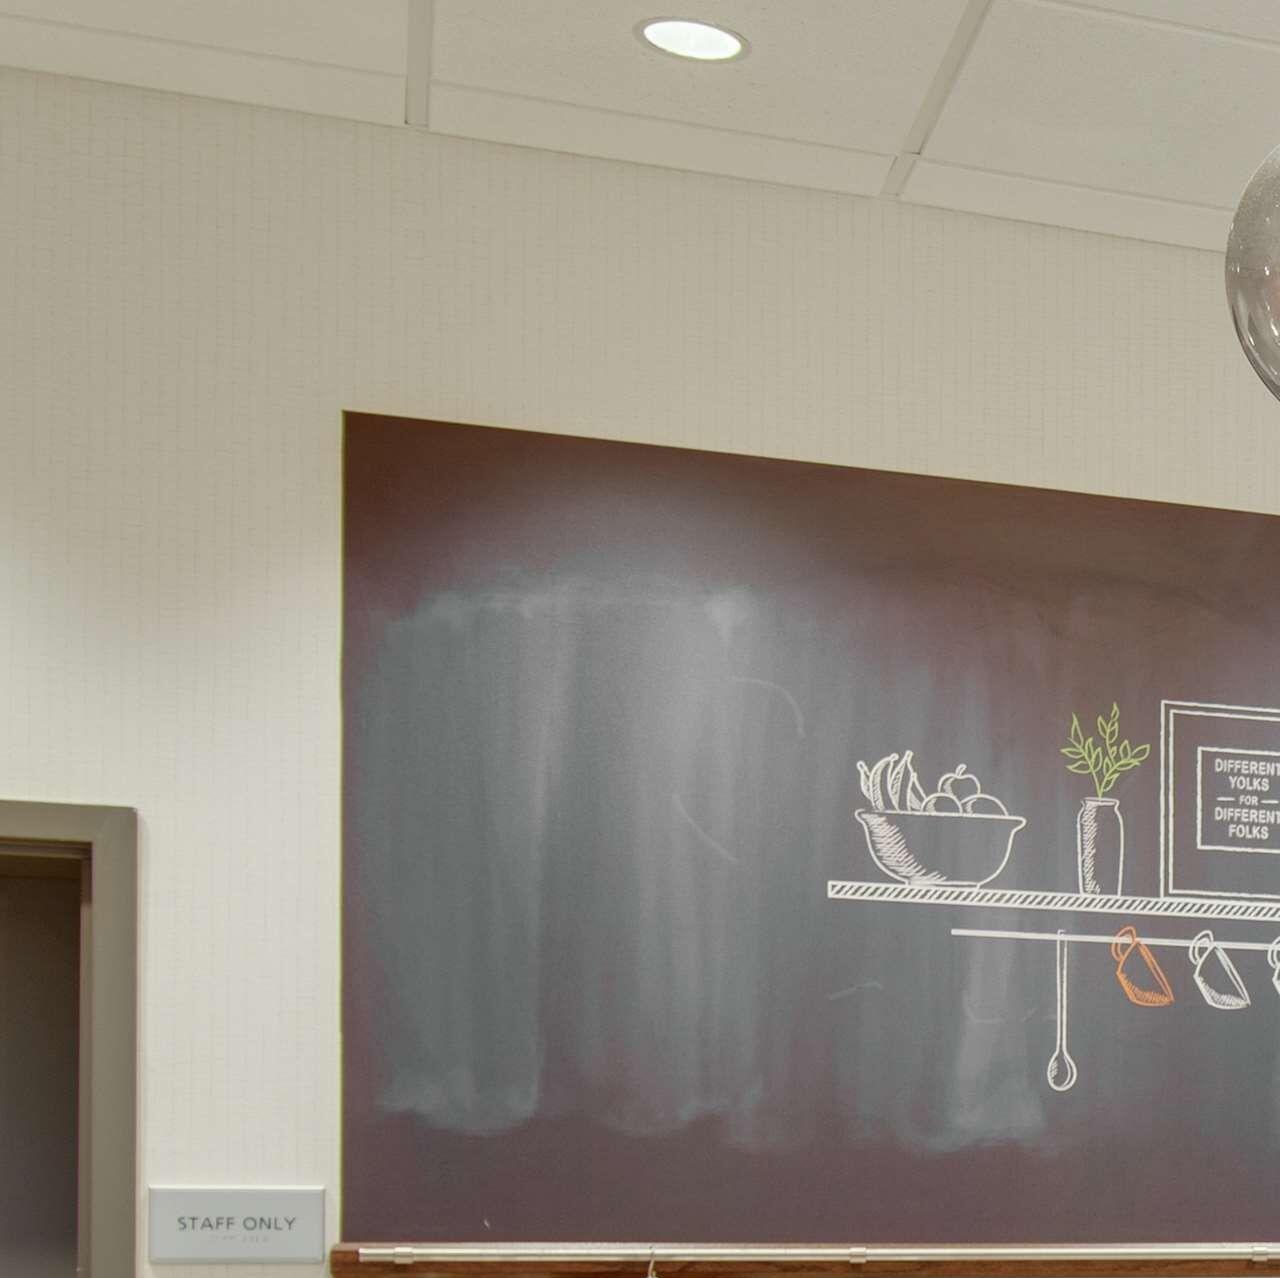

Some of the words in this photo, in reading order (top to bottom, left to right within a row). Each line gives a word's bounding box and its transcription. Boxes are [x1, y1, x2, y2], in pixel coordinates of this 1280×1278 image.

[1228, 776, 1270, 791] YOLKS
[1239, 795, 1259, 806] FOR
[1228, 824, 1269, 840] FOLKS
[177, 1216, 235, 1231] STAFF
[242, 1216, 297, 1231] ONLY
